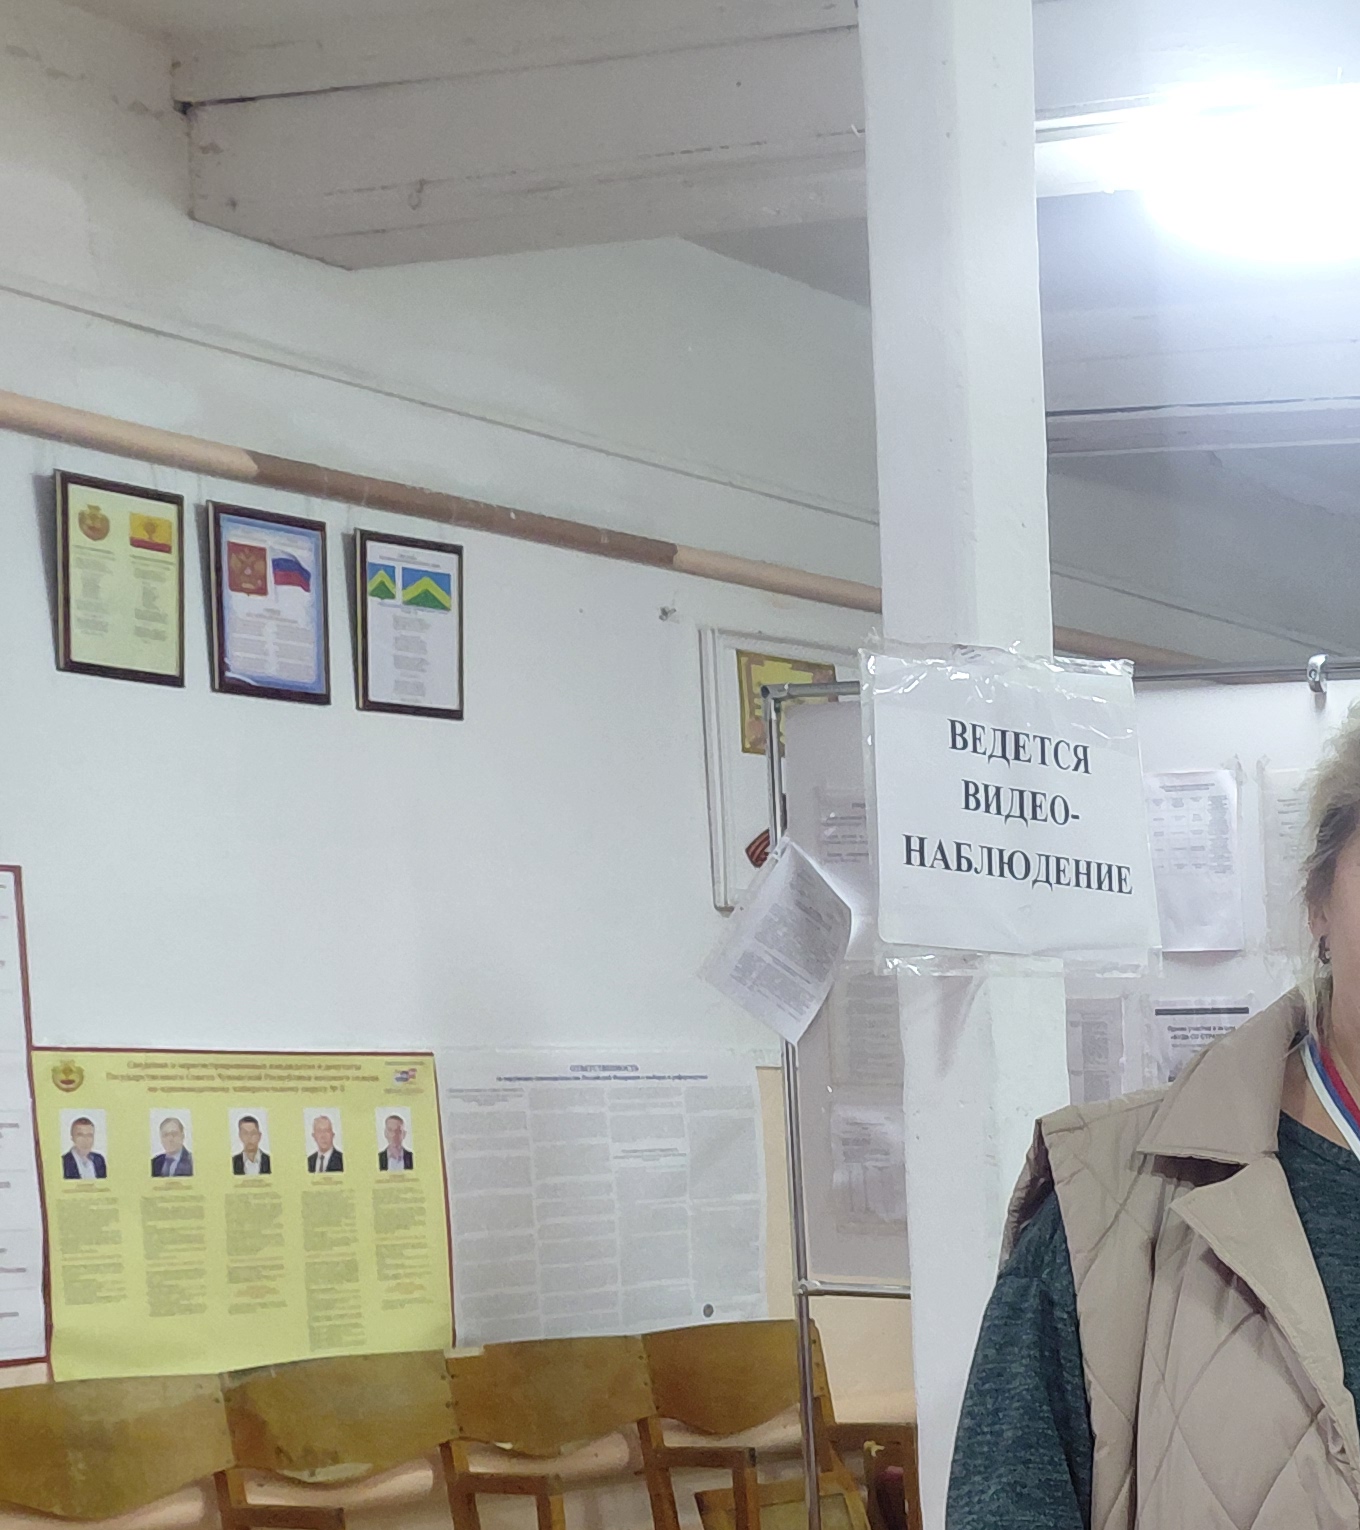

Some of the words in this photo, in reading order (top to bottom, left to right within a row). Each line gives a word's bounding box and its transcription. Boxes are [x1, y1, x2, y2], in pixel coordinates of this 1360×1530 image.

[947, 718, 1092, 775] ВЕДЕТСЯ
[961, 779, 1080, 828] ВИДЕО-
[902, 833, 1133, 895] НАБЛЮДЕНИЕ
